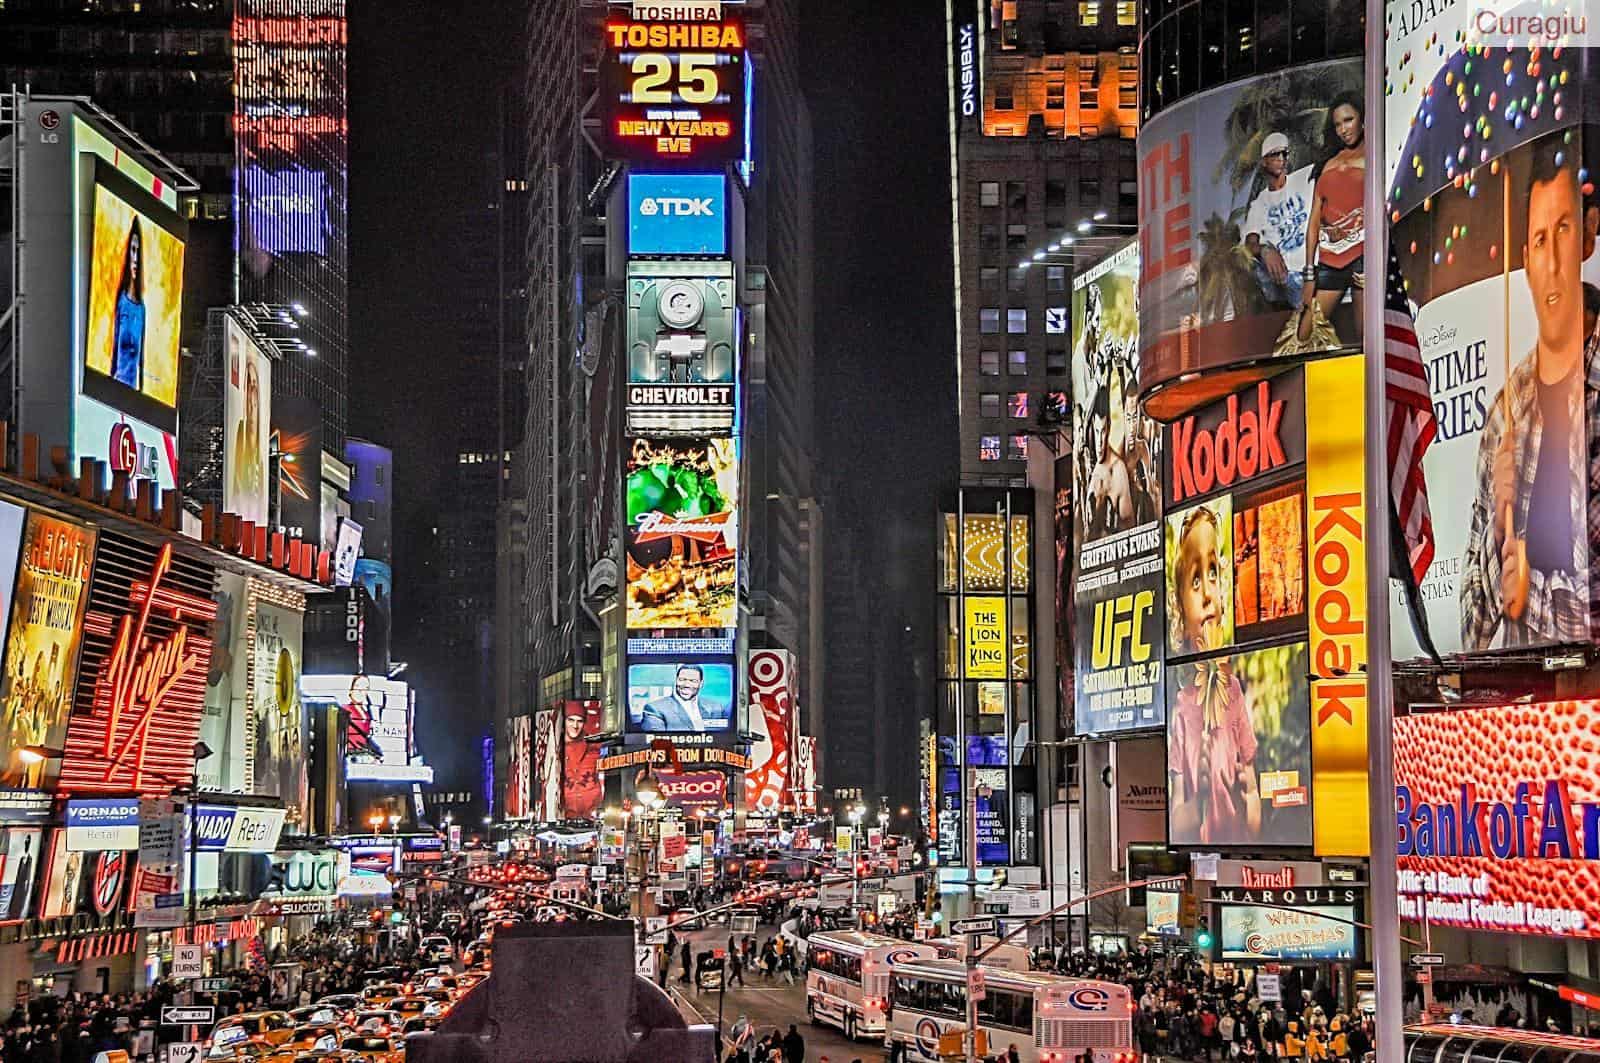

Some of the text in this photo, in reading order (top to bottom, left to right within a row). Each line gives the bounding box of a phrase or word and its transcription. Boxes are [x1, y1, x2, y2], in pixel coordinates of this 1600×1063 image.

[636, 7, 718, 20] TOSHIBA
[608, 25, 742, 48] TOSHIBA
[632, 53, 719, 104] 25
[619, 120, 729, 136] NEW YEAR'S
[40, 133, 59, 144] LG
[656, 137, 692, 153] EVE
[655, 198, 714, 216] TDK
[1423, 340, 1488, 395] TIME
[631, 387, 730, 404] CHEVROLET
[1434, 386, 1488, 445] RIES
[1172, 380, 1288, 503] Kodak
[1080, 542, 1117, 570] GRIFFIN
[1129, 528, 1161, 556] EVANS
[346, 588, 359, 642] 1500
[974, 612, 997, 624] THE
[1313, 491, 1365, 727] Kodak
[970, 627, 1001, 646] LION
[1091, 590, 1154, 671] UFC
[970, 648, 1002, 667] KING
[1127, 663, 1149, 687] DEC.
[1148, 660, 1161, 684] 27
[68, 806, 139, 817] VORNADO
[1395, 779, 1600, 860] Bank of A
[237, 817, 274, 841] Retail
[976, 828, 991, 836] OCK
[1397, 869, 1490, 897] ffical Bank of
[1220, 889, 1355, 903] MARQUIS
[281, 900, 325, 914] swatch
[1471, 898, 1525, 926] Football
[181, 951, 194, 960] NO
[175, 963, 200, 973] TURNS
[172, 1046, 188, 1056] NO
